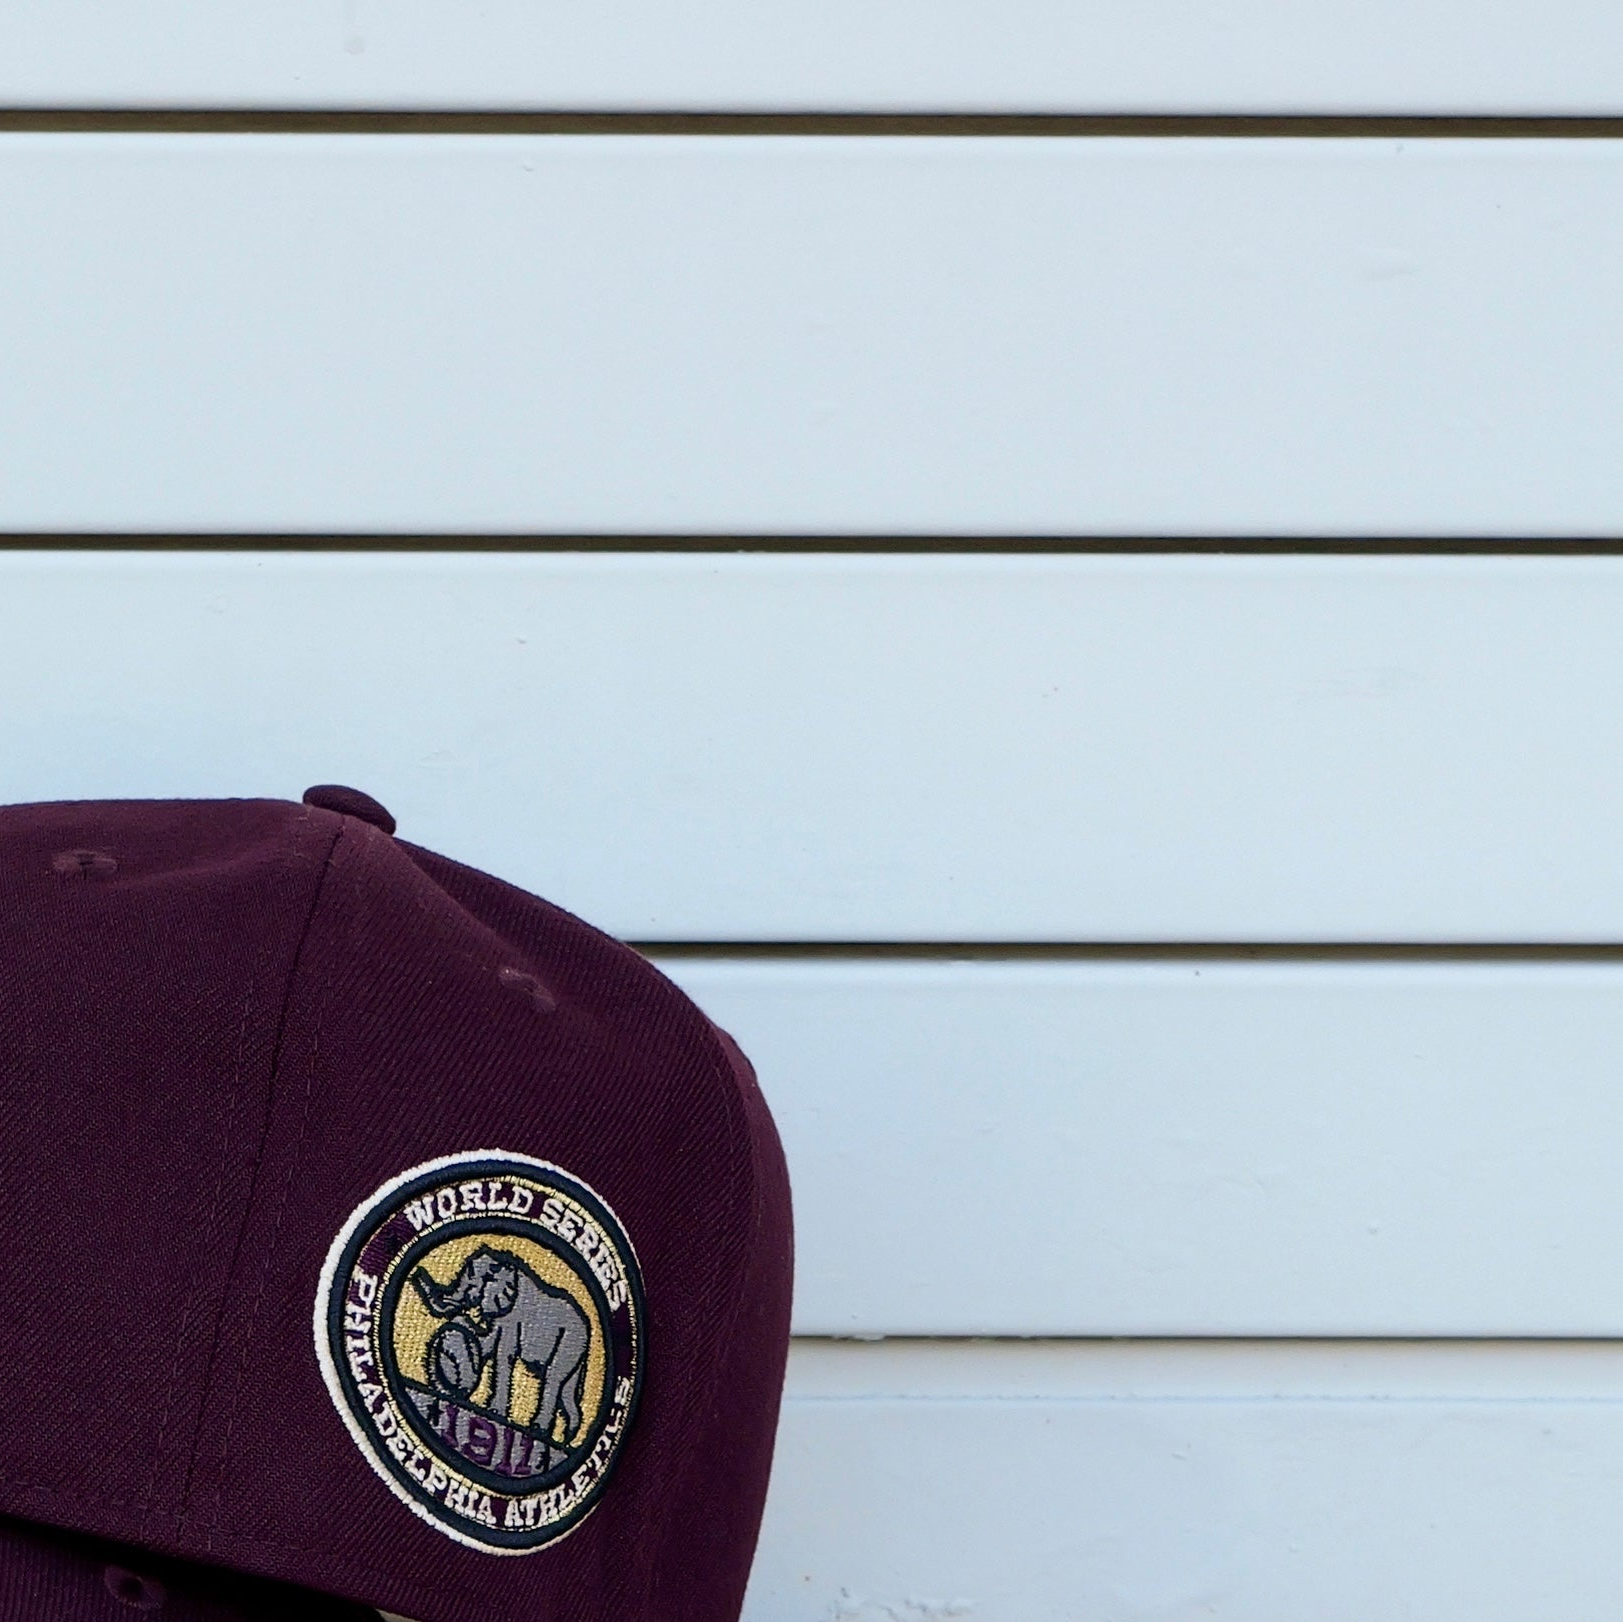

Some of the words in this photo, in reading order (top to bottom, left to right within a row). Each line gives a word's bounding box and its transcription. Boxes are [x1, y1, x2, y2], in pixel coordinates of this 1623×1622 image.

[404, 1181, 534, 1231] WORLD
[540, 1198, 627, 1311] SERIES
[344, 1268, 497, 1525] PHILADELPHIA
[504, 1376, 630, 1528] ATHLETICS
[442, 1403, 535, 1477] 1911
